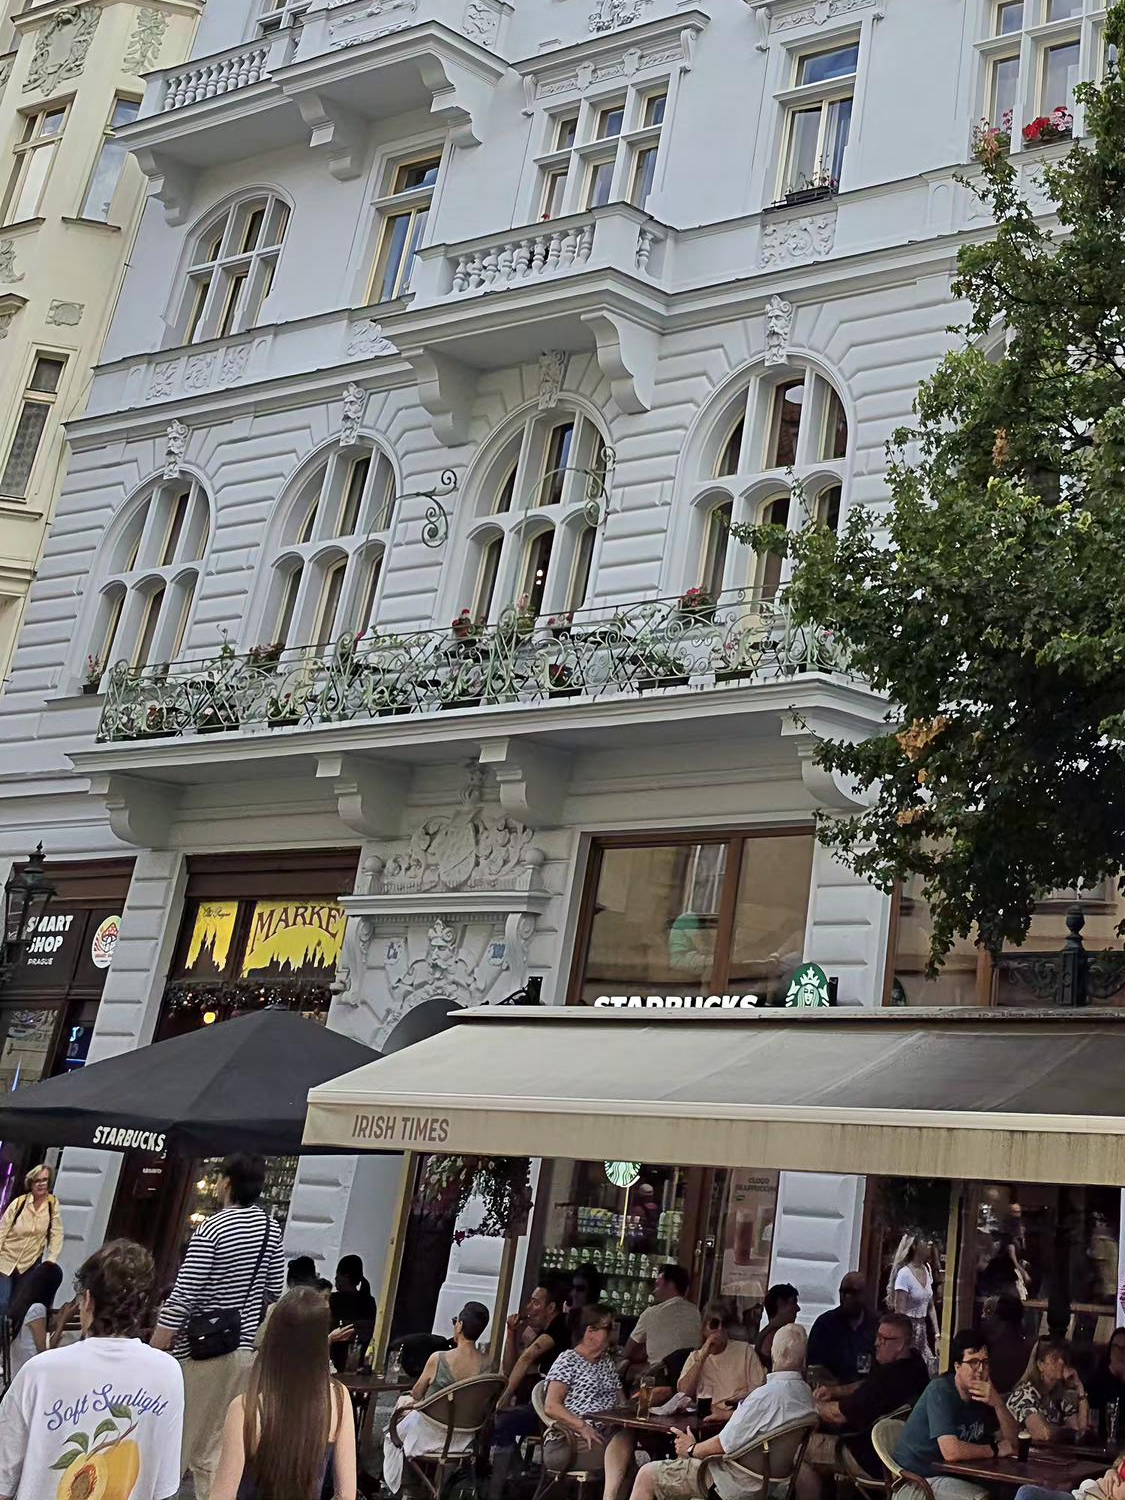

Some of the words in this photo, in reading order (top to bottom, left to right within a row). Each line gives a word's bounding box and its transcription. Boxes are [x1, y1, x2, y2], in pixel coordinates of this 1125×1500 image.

[248, 905, 344, 956] MARKE
[93, 1125, 166, 1152] STARBUCKS
[352, 1114, 396, 1140] IRISH
[401, 1117, 450, 1142] TIMES
[43, 1394, 89, 1431] Soft
[92, 1383, 169, 1417] Sunlight
